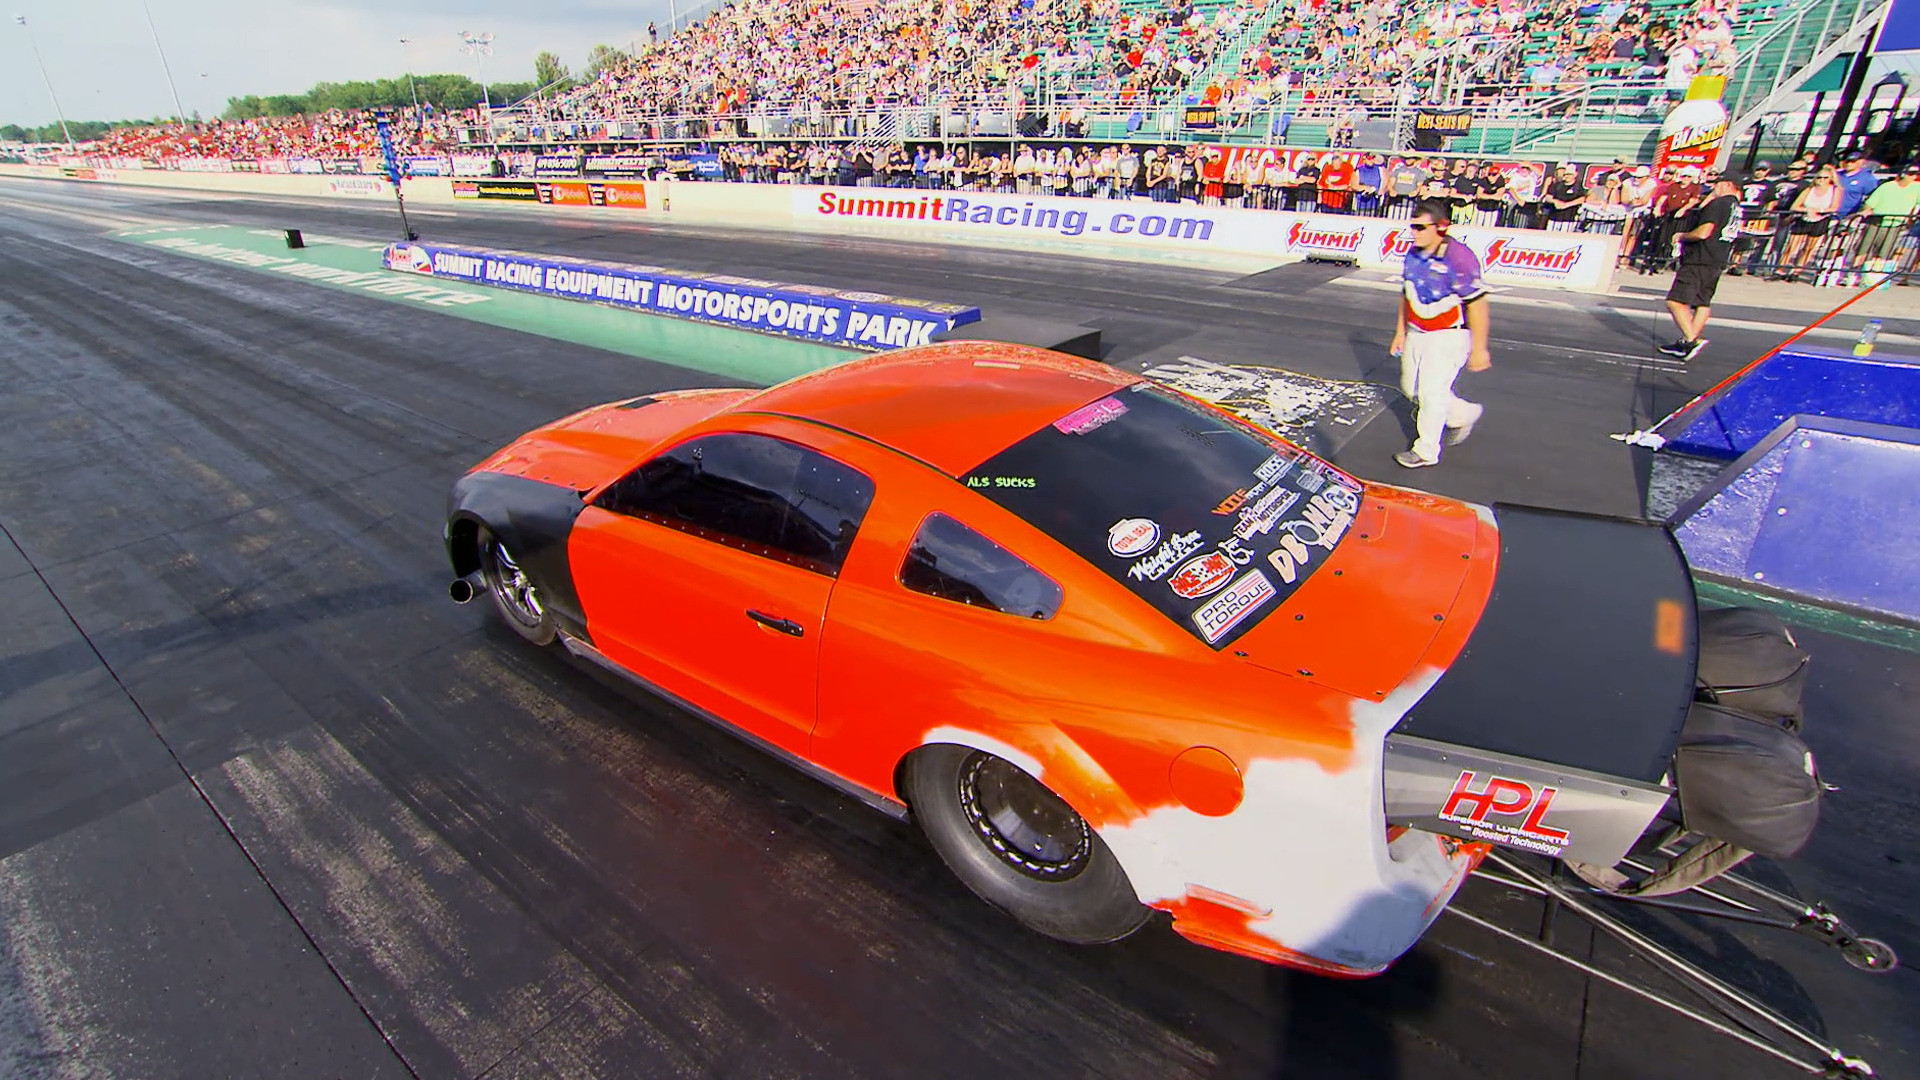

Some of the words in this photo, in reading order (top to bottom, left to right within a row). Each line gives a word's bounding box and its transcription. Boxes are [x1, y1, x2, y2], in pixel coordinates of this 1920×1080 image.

[818, 191, 1214, 241] SummitRacing.com
[1287, 221, 1361, 250] SUMMIT
[1484, 239, 1577, 270] SUMMIT
[434, 251, 483, 278] SUMMIT
[486, 261, 542, 288] RACING
[546, 268, 653, 305] EQUIPMENT
[657, 284, 840, 336] MOTORSPORTS
[845, 312, 937, 347] PARK
[967, 476, 990, 488] ALS
[995, 477, 1036, 488] SUCKS
[1114, 532, 1138, 550] TOTAL
[1201, 591, 1238, 621] PRO
[1204, 582, 1270, 631] TORQUE
[1439, 770, 1570, 841] HPL
[1472, 827, 1509, 843] Boosted
[1510, 835, 1562, 855] Technology
